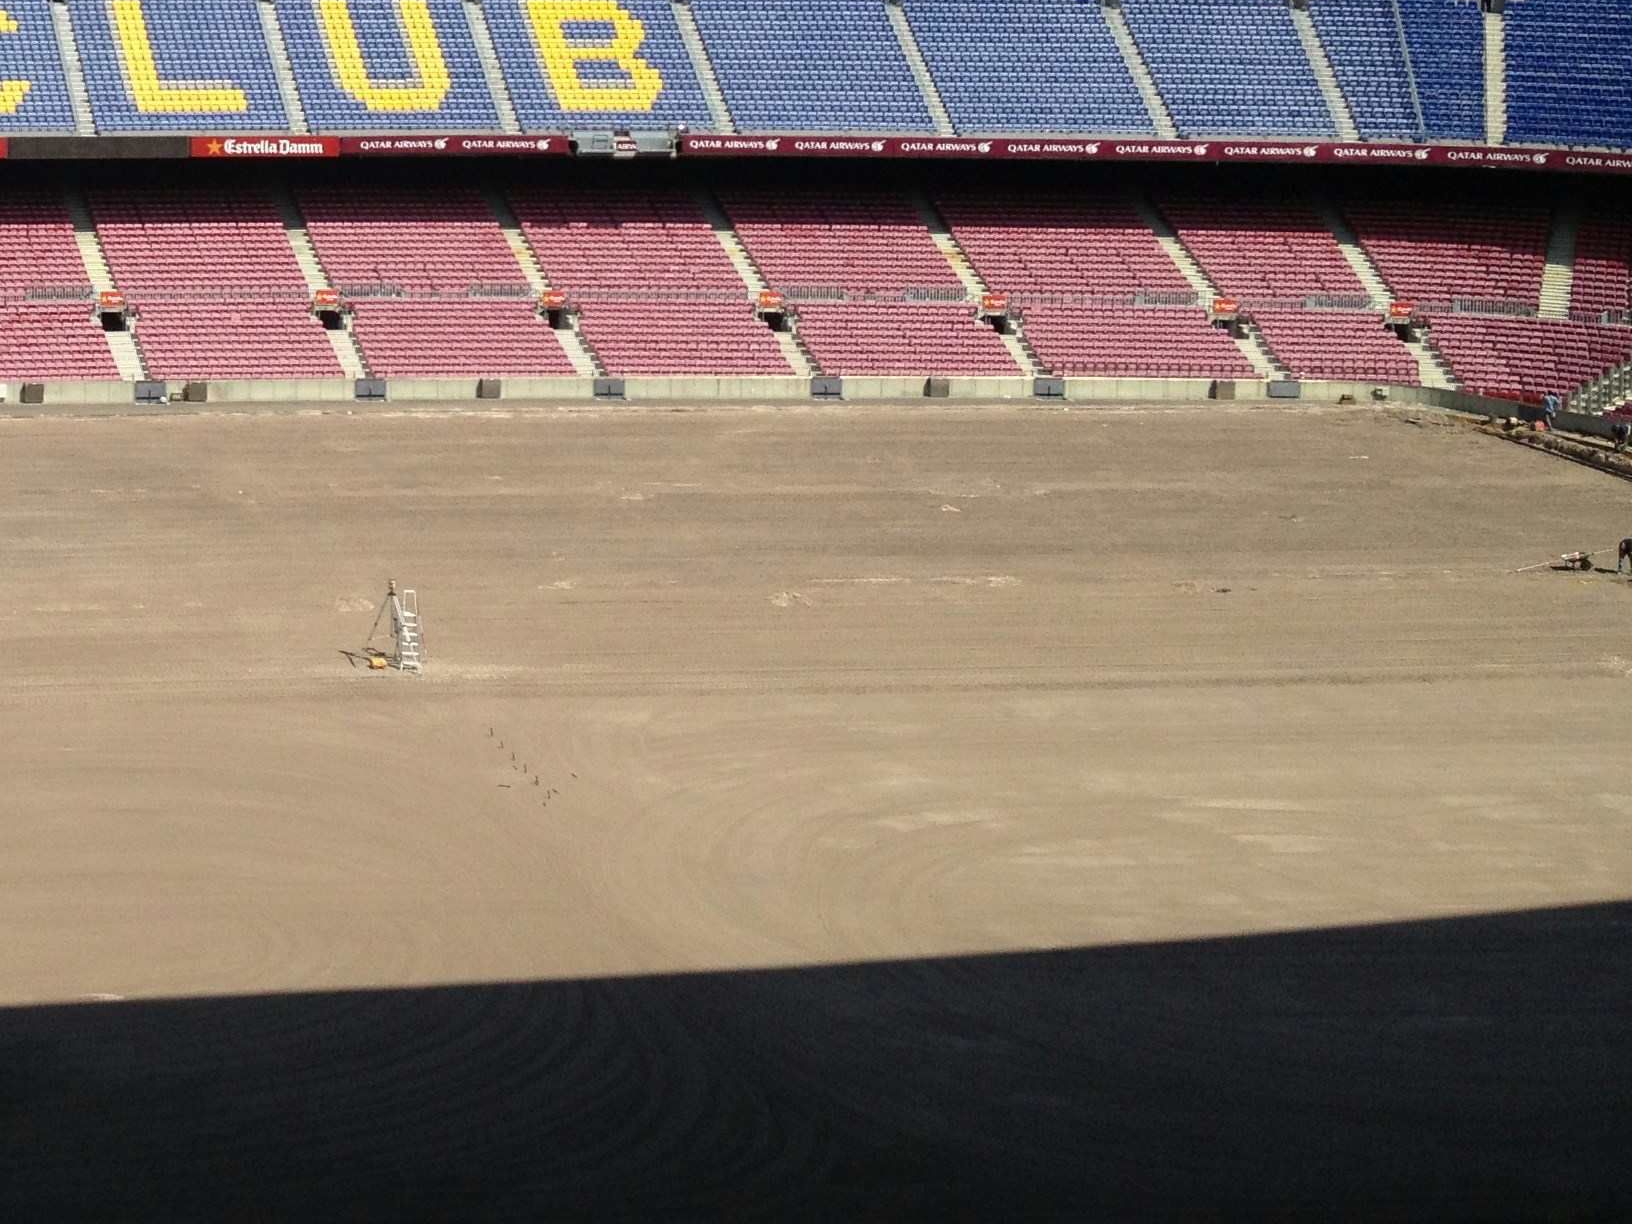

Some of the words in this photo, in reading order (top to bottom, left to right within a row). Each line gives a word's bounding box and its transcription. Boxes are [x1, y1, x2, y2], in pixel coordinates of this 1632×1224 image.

[223, 138, 277, 154] Estrella
[279, 139, 324, 154] Damm
[361, 141, 391, 149] QATAR
[463, 141, 494, 149] QATAR
[690, 140, 721, 148] QATAR
[795, 142, 827, 150] QATAR
[901, 143, 933, 151] QATAR
[1116, 146, 1149, 154] QATAR
[1225, 147, 1257, 155] QATAR
[1447, 151, 1483, 160] QATAR
[1486, 152, 1531, 162] AIRWAYS
